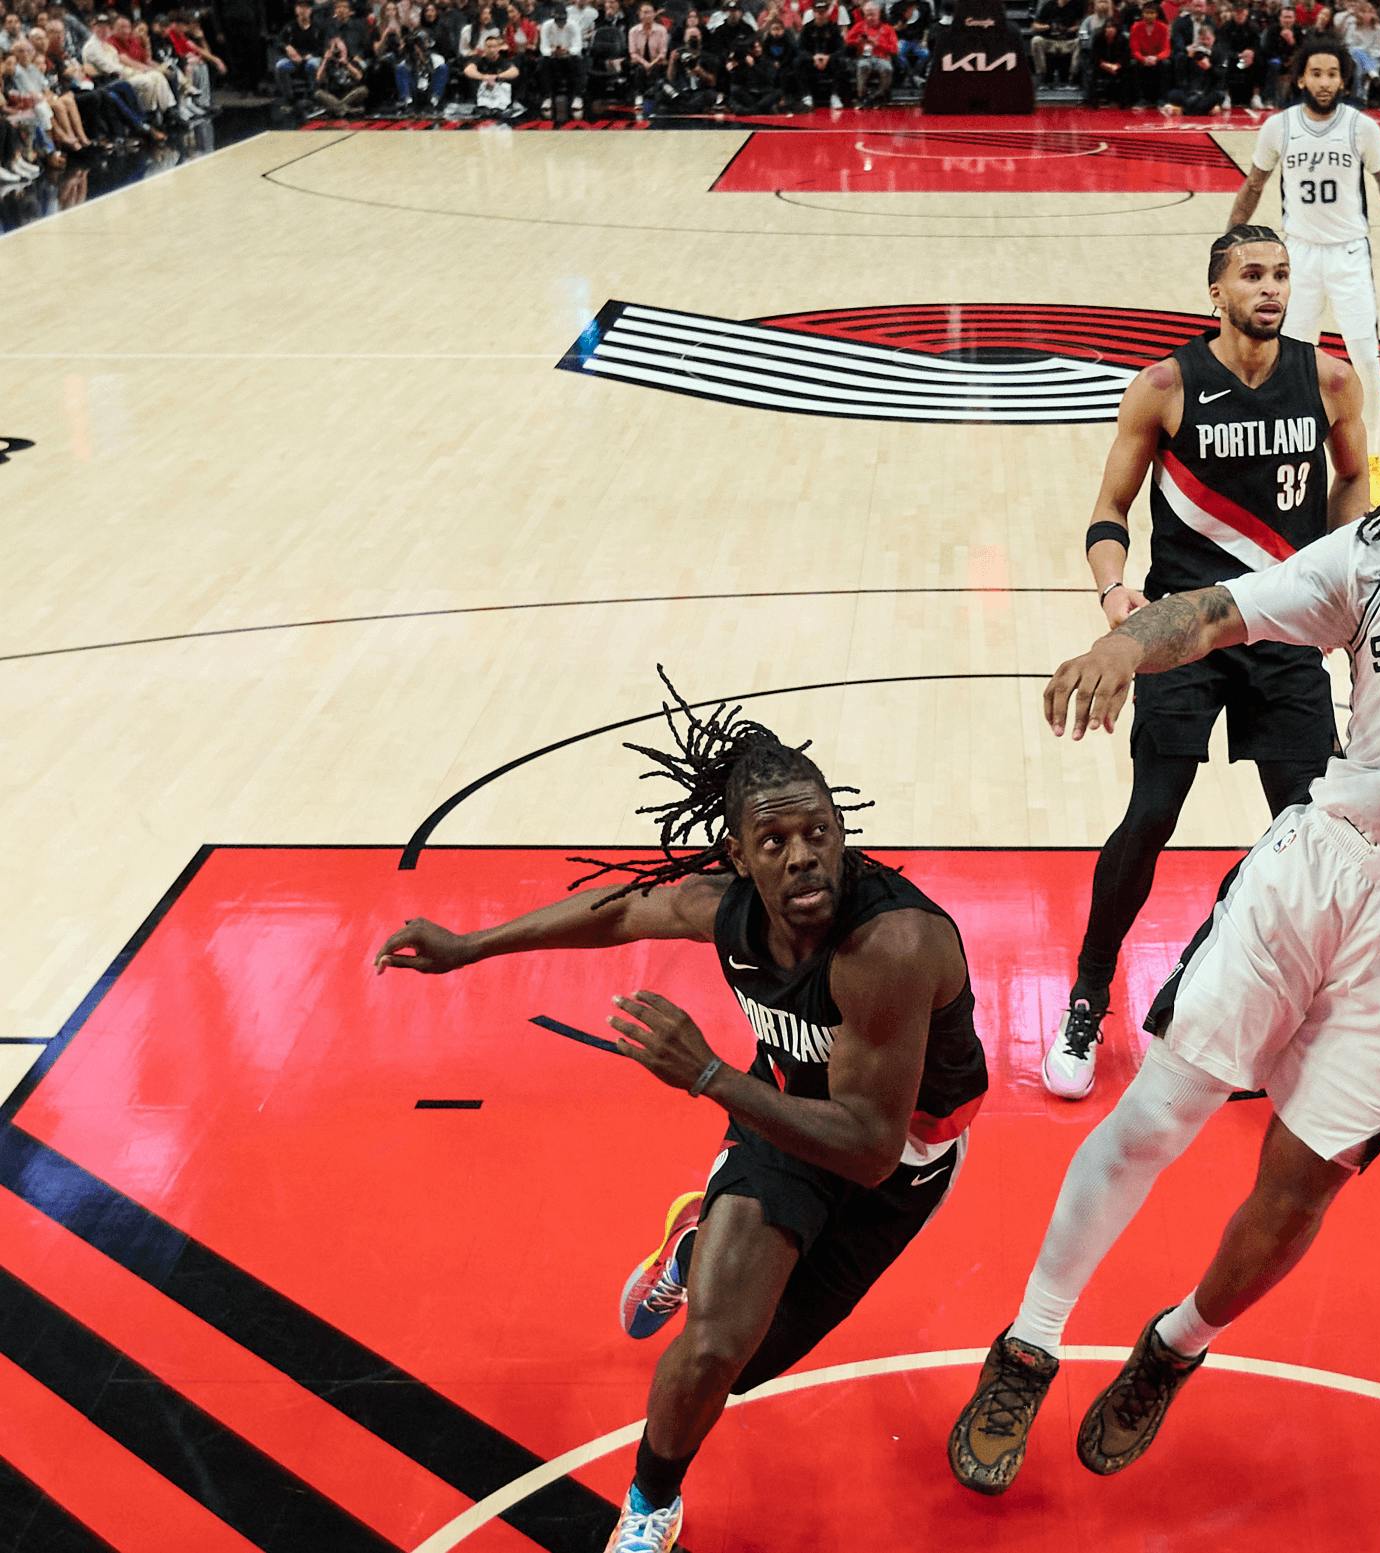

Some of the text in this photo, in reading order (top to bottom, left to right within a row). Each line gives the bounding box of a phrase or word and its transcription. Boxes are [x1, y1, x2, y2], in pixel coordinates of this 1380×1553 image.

[942, 52, 1017, 71] KIA
[1286, 151, 1352, 172] SPURS
[1300, 179, 1338, 204] 30
[1196, 417, 1317, 459] PORTLAND
[1276, 461, 1311, 512] 33
